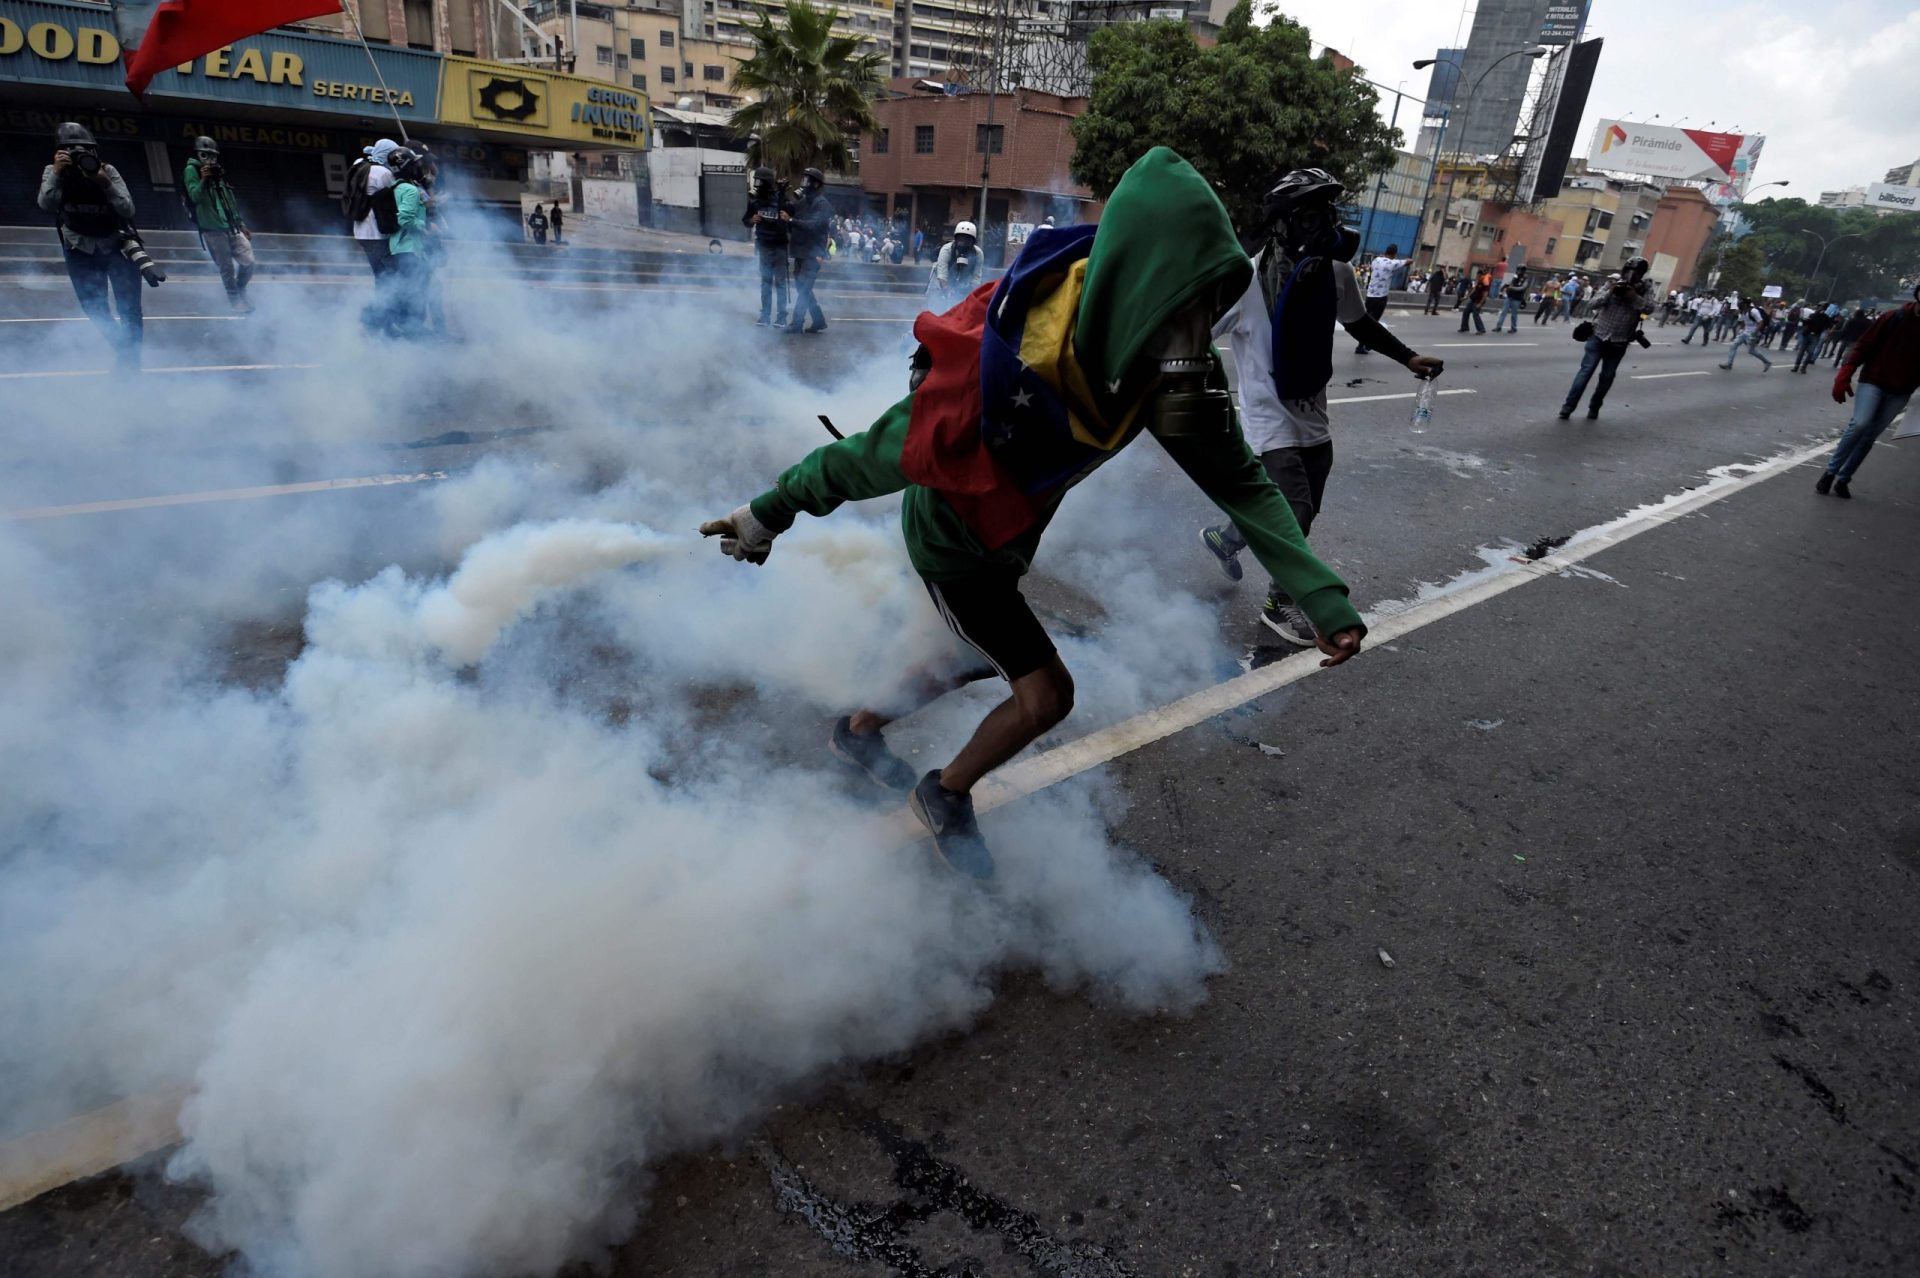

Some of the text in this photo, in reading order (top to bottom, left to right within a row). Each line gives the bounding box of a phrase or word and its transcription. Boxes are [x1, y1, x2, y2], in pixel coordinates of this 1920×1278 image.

[313, 80, 415, 107] SERTECA
[588, 88, 639, 110] GRUPO
[571, 102, 643, 133] INVICTA
[182, 122, 329, 149] ALINEACION
[1878, 192, 1916, 205] billboard
